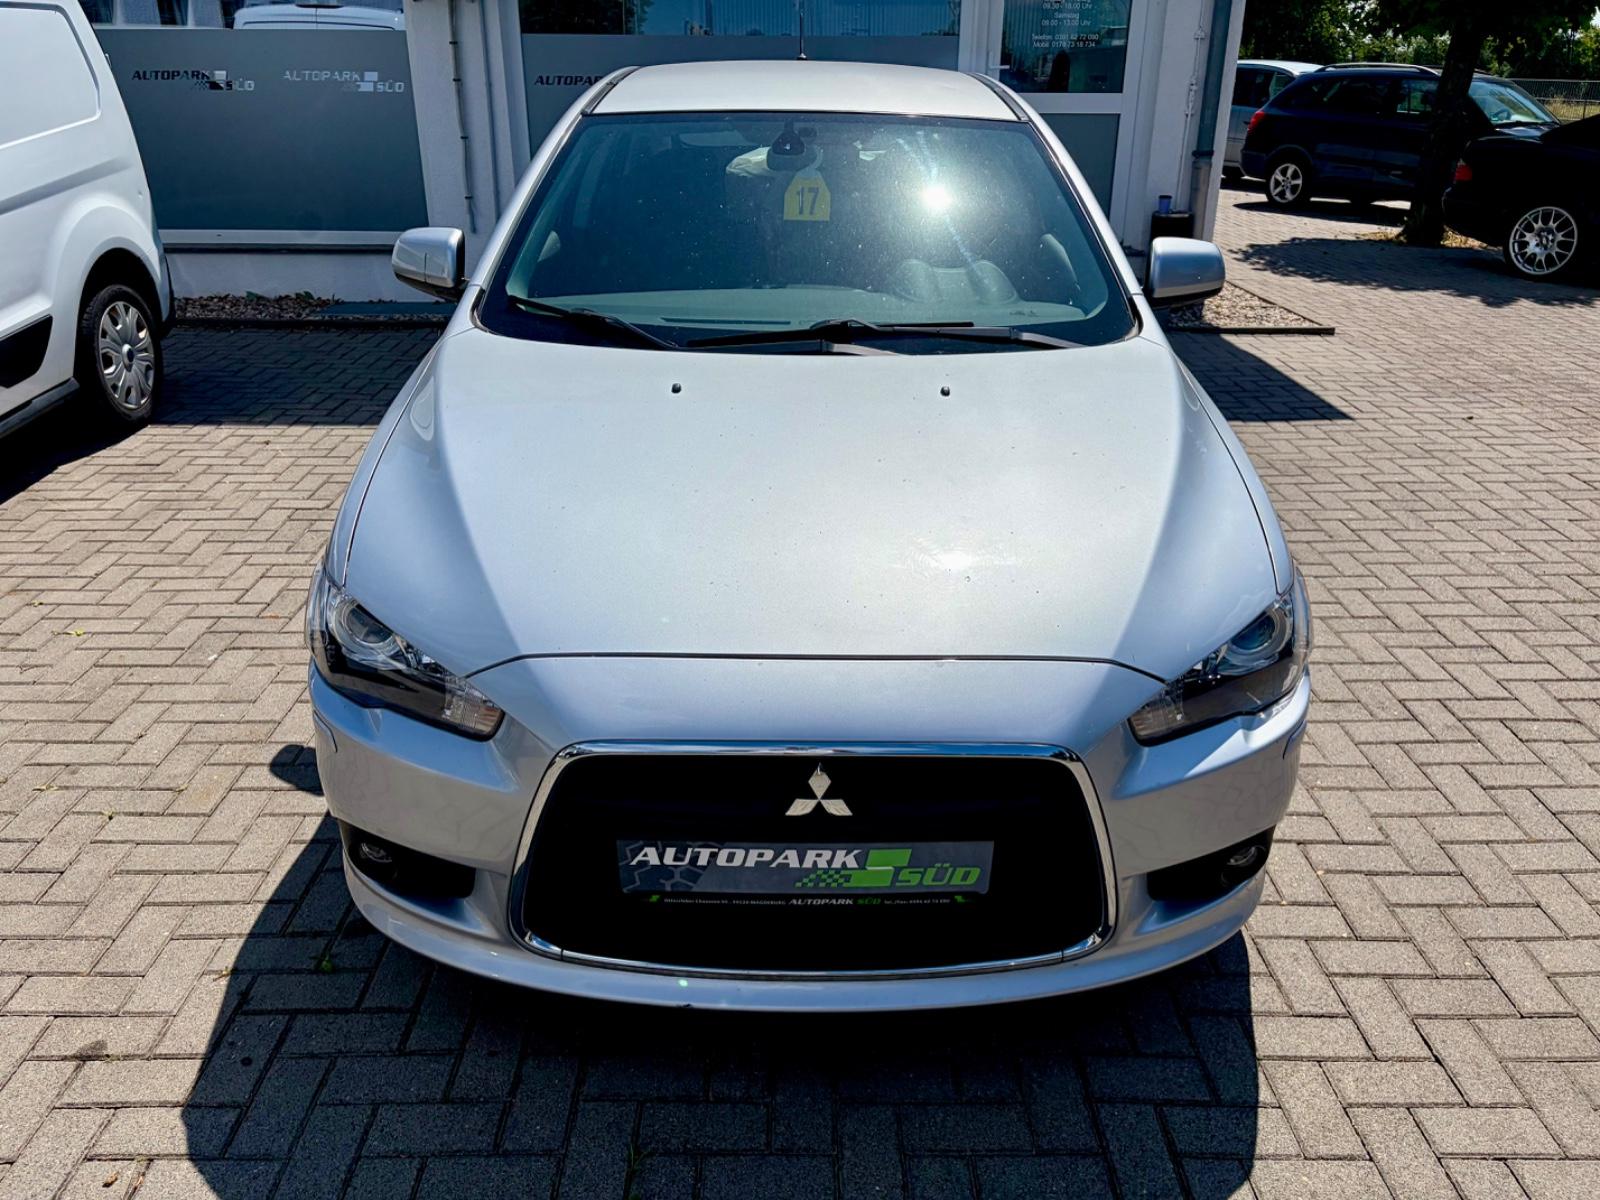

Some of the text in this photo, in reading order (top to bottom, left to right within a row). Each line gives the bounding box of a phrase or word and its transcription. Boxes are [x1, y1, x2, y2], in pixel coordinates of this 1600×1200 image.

[131, 70, 211, 81] AUTOPARK
[283, 70, 361, 82] AUTOPARK
[797, 186, 819, 215] 17
[630, 847, 862, 869] AUTOPARK
[896, 863, 981, 886] SÜD
[856, 897, 882, 905] SÜD
